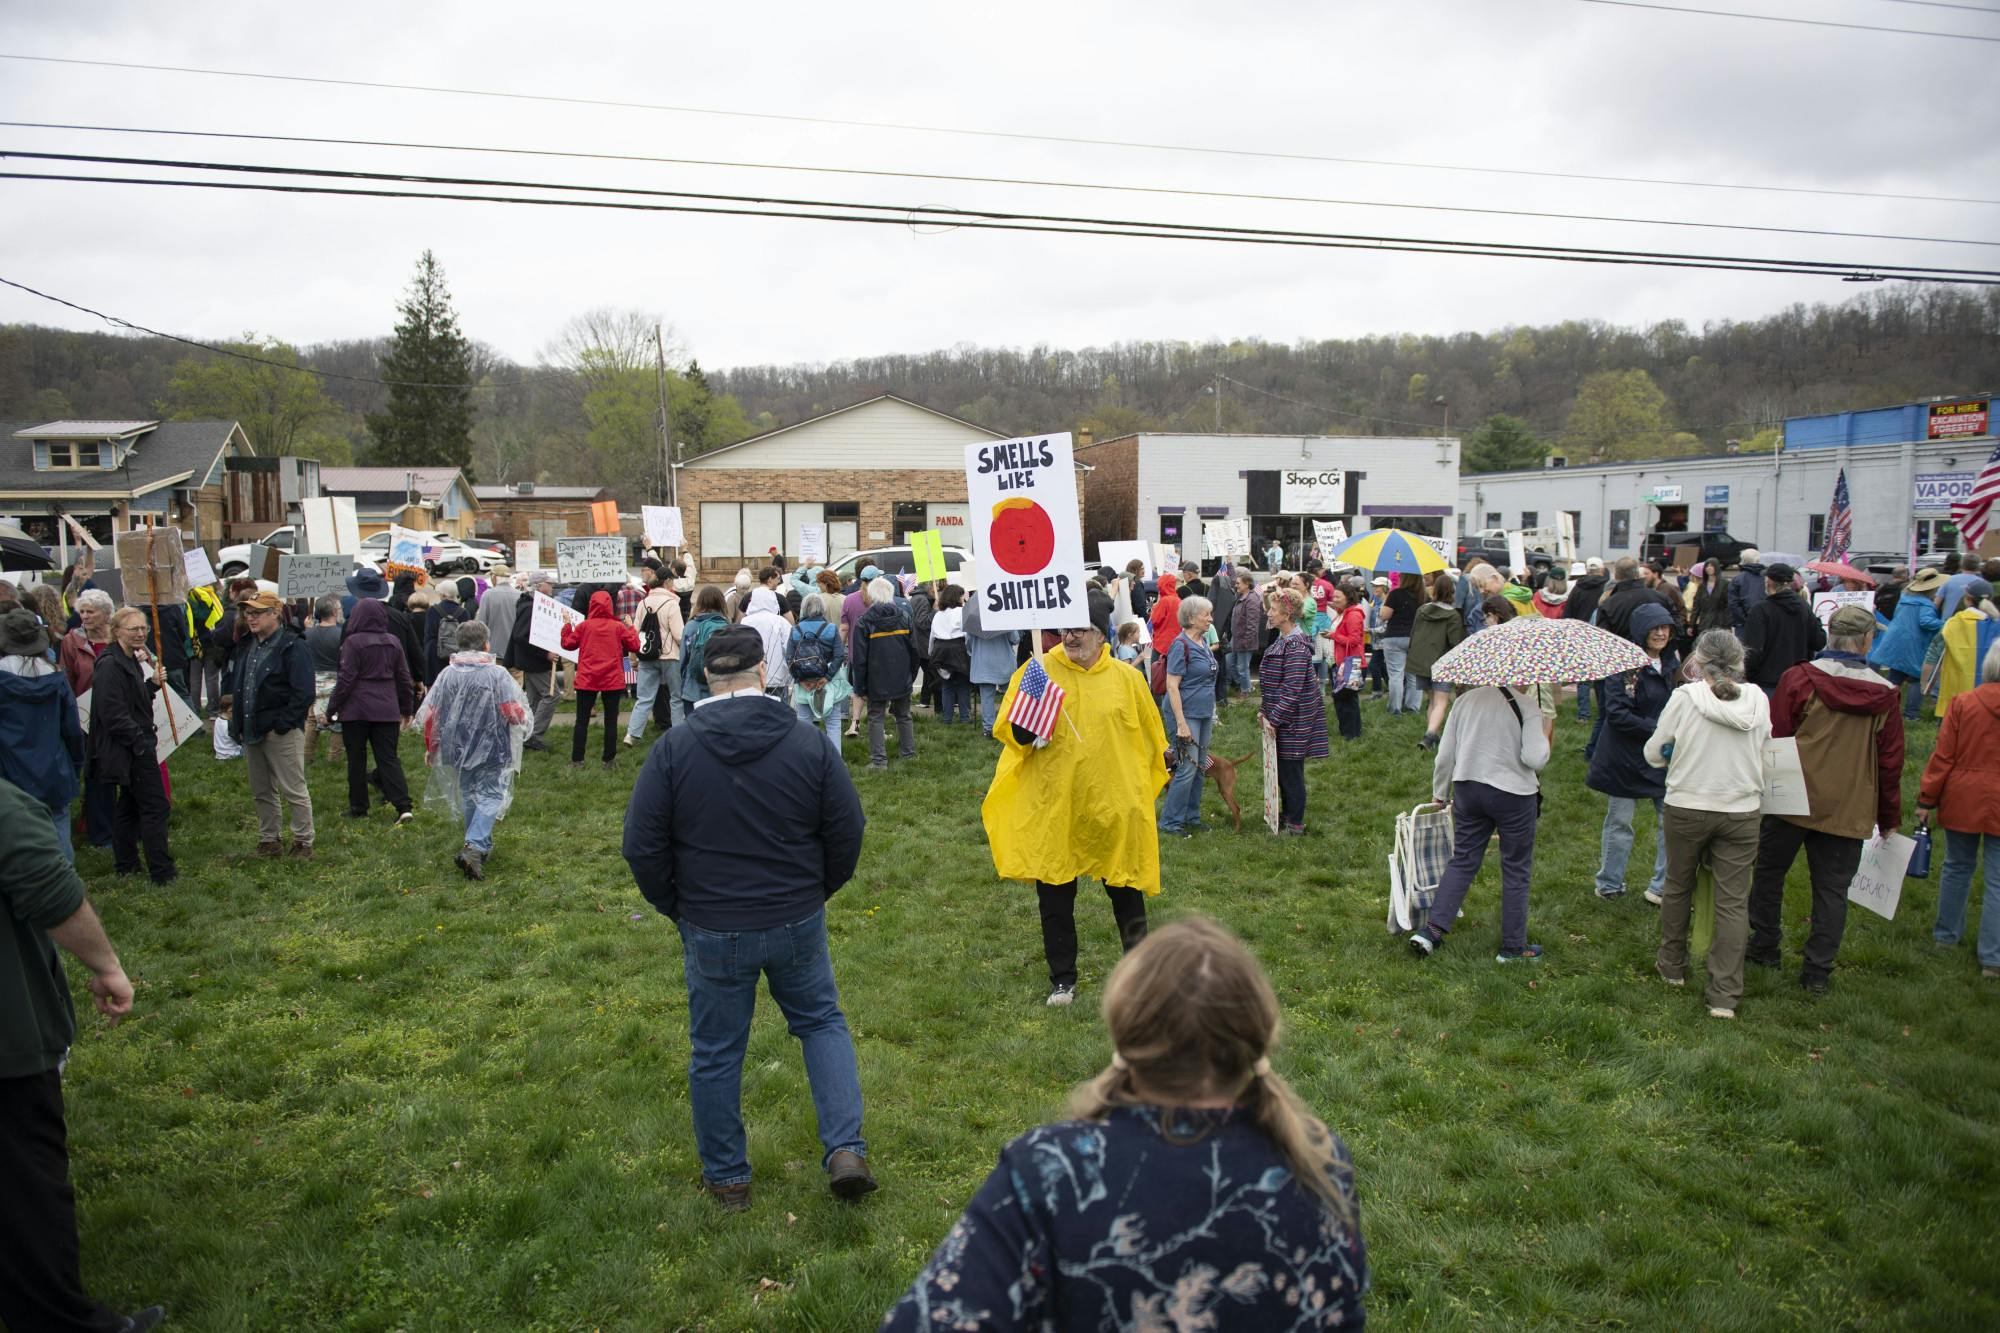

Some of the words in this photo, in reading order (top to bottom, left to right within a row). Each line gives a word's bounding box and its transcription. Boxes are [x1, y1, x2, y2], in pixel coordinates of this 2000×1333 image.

[1936, 406, 1955, 415] FOR
[1957, 403, 1980, 413] HIRE
[1930, 413, 1985, 425] EXCAVATION
[1933, 422, 1980, 433] FORESTRY
[977, 440, 1054, 474] SMELLS
[998, 470, 1035, 490] LIKE
[1286, 472, 1317, 489] Shop
[1916, 482, 1972, 498] VAPOR
[935, 516, 964, 526] PANDA
[289, 557, 312, 569] Are
[316, 556, 341, 568] The
[287, 569, 320, 580] Same
[320, 567, 347, 577] That
[592, 568, 615, 579] Great
[287, 580, 314, 596] Burn
[987, 574, 1072, 612] SHITLER
